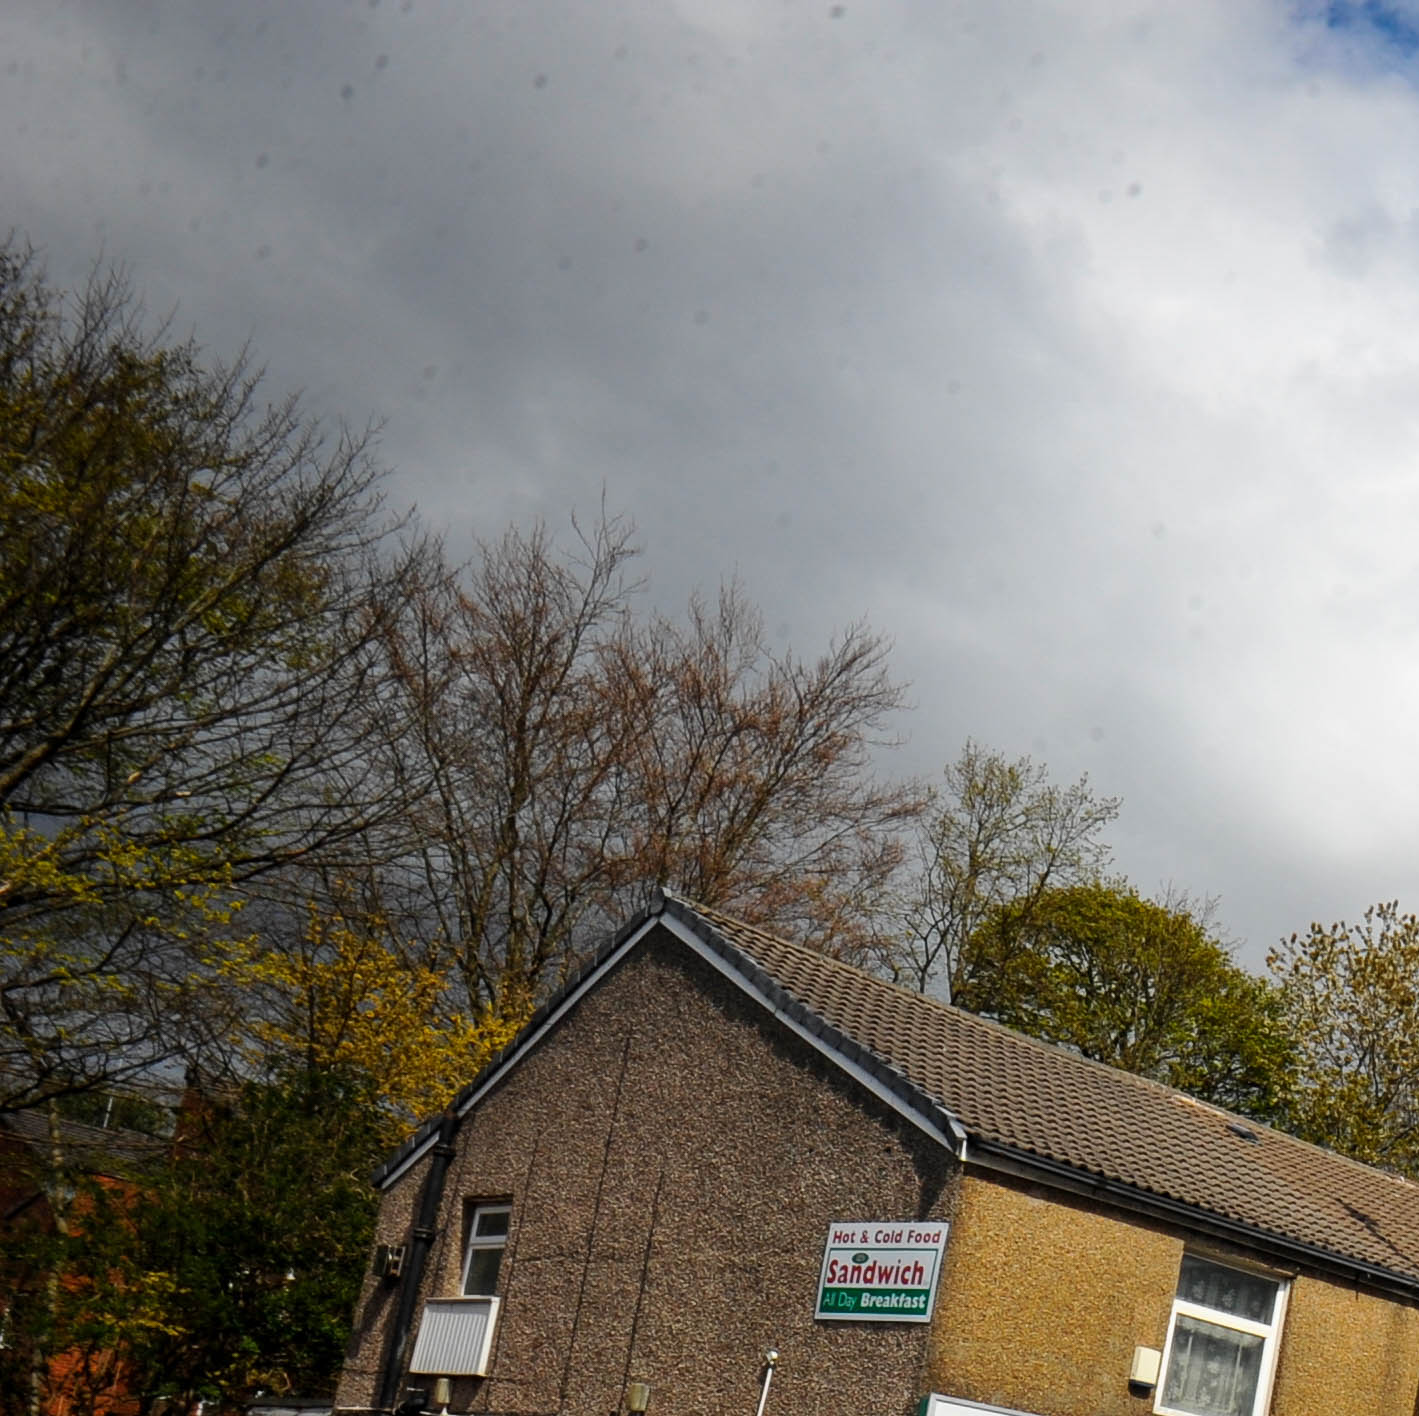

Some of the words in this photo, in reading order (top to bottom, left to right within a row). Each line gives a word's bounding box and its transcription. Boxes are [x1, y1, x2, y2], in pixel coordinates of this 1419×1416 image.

[832, 1230, 855, 1244] Hot
[860, 1230, 869, 1244] &
[874, 1229, 903, 1244] Cold
[907, 1229, 942, 1244] Food
[827, 1259, 924, 1285] Sandwich
[838, 1291, 857, 1311] Day
[860, 1292, 927, 1309] Breakfast
